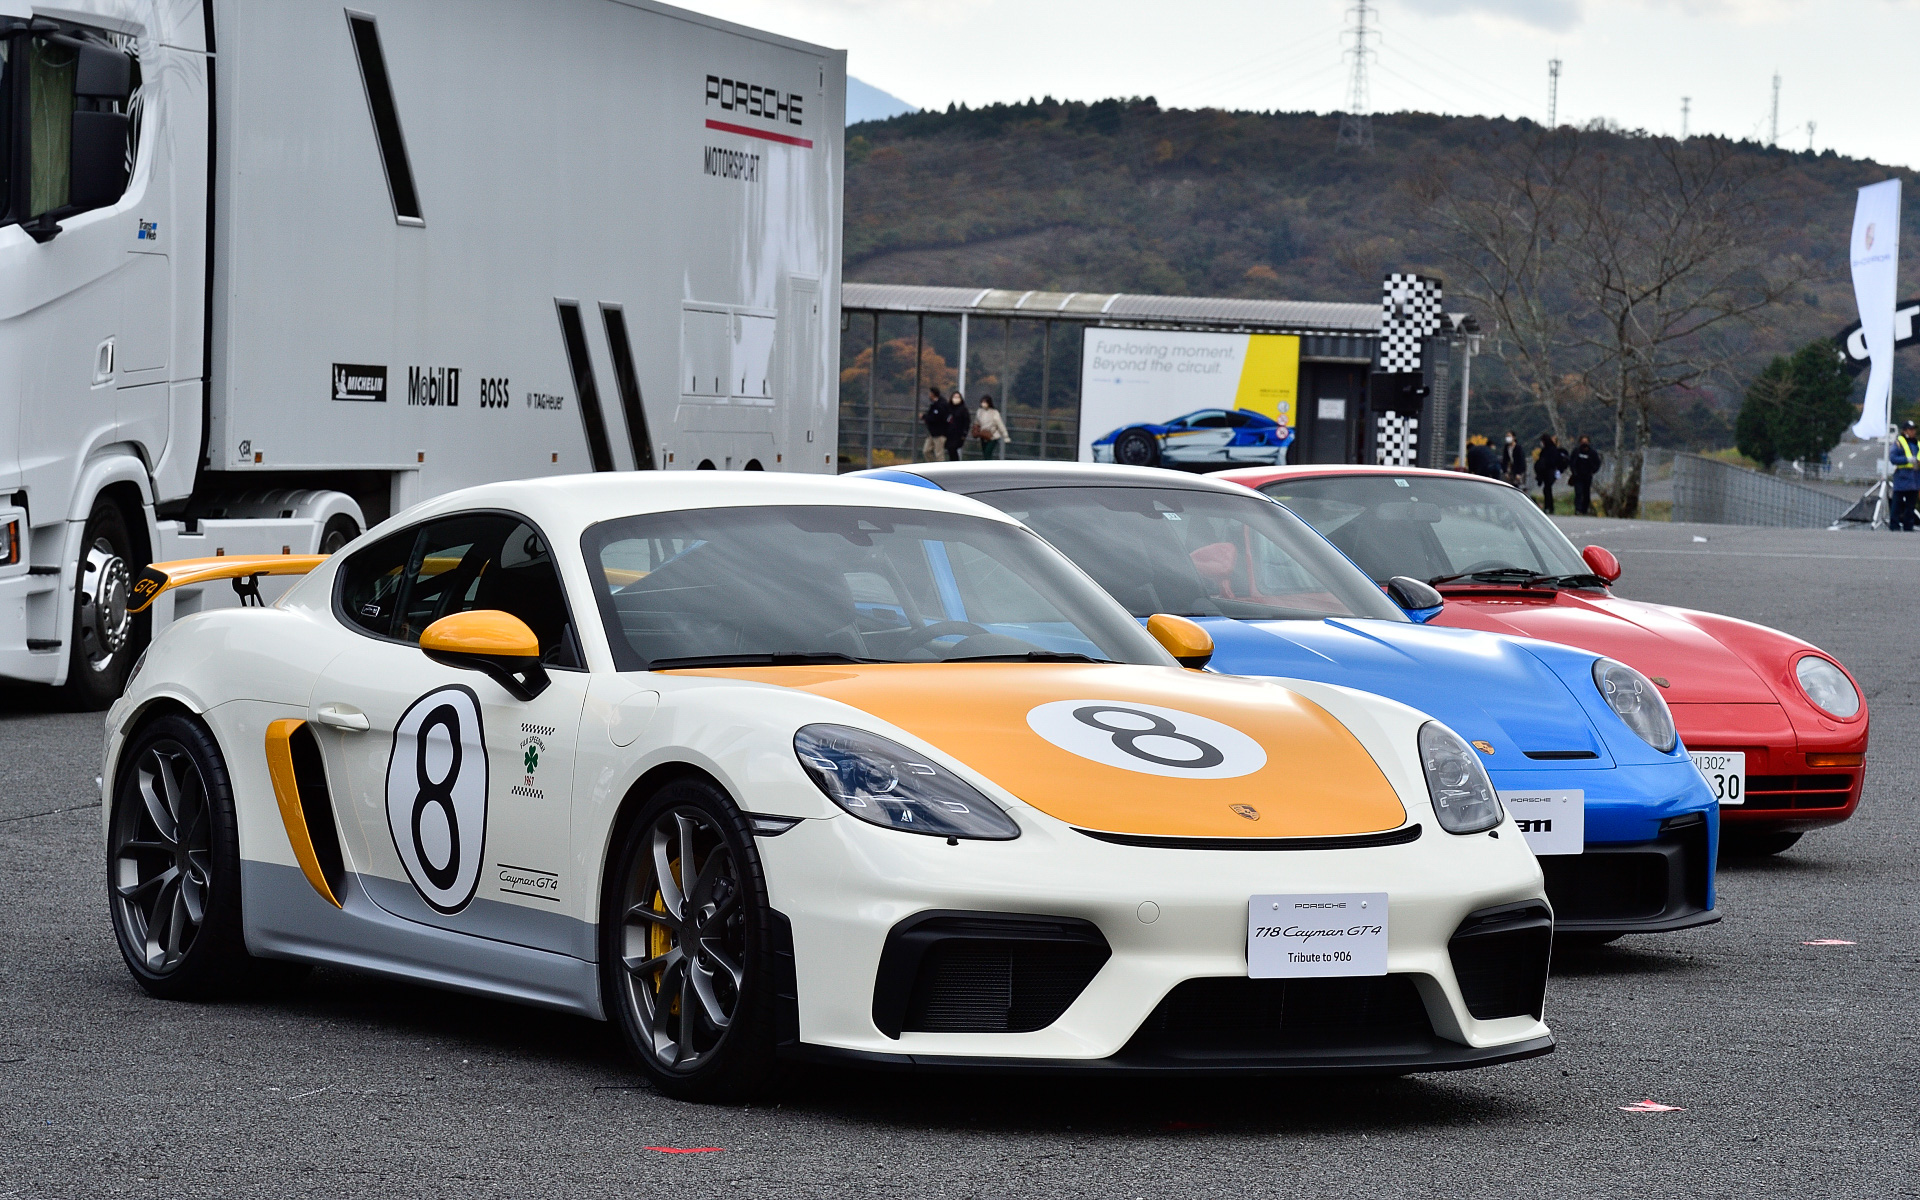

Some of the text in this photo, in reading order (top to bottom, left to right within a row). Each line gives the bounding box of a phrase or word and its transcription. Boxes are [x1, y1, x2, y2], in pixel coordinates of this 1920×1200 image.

[705, 74, 803, 126] PORSCHE
[704, 145, 760, 182] MOTORSPORT
[1095, 340, 1236, 360] Fun-loving moment,
[1092, 356, 1223, 374] Beyond the circuit.
[347, 375, 384, 392] MICHELIN
[407, 365, 445, 406] Mobil
[480, 378, 509, 409] BOSS
[134, 578, 159, 597] GT4
[1072, 705, 1225, 769] 8
[523, 775, 535, 787] 1967
[411, 704, 463, 891] 8
[499, 870, 558, 891] Cayman GT4
[1255, 927, 1282, 938] 718
[1283, 926, 1344, 944] Cayman
[1288, 951, 1352, 963] Tribute to 906
